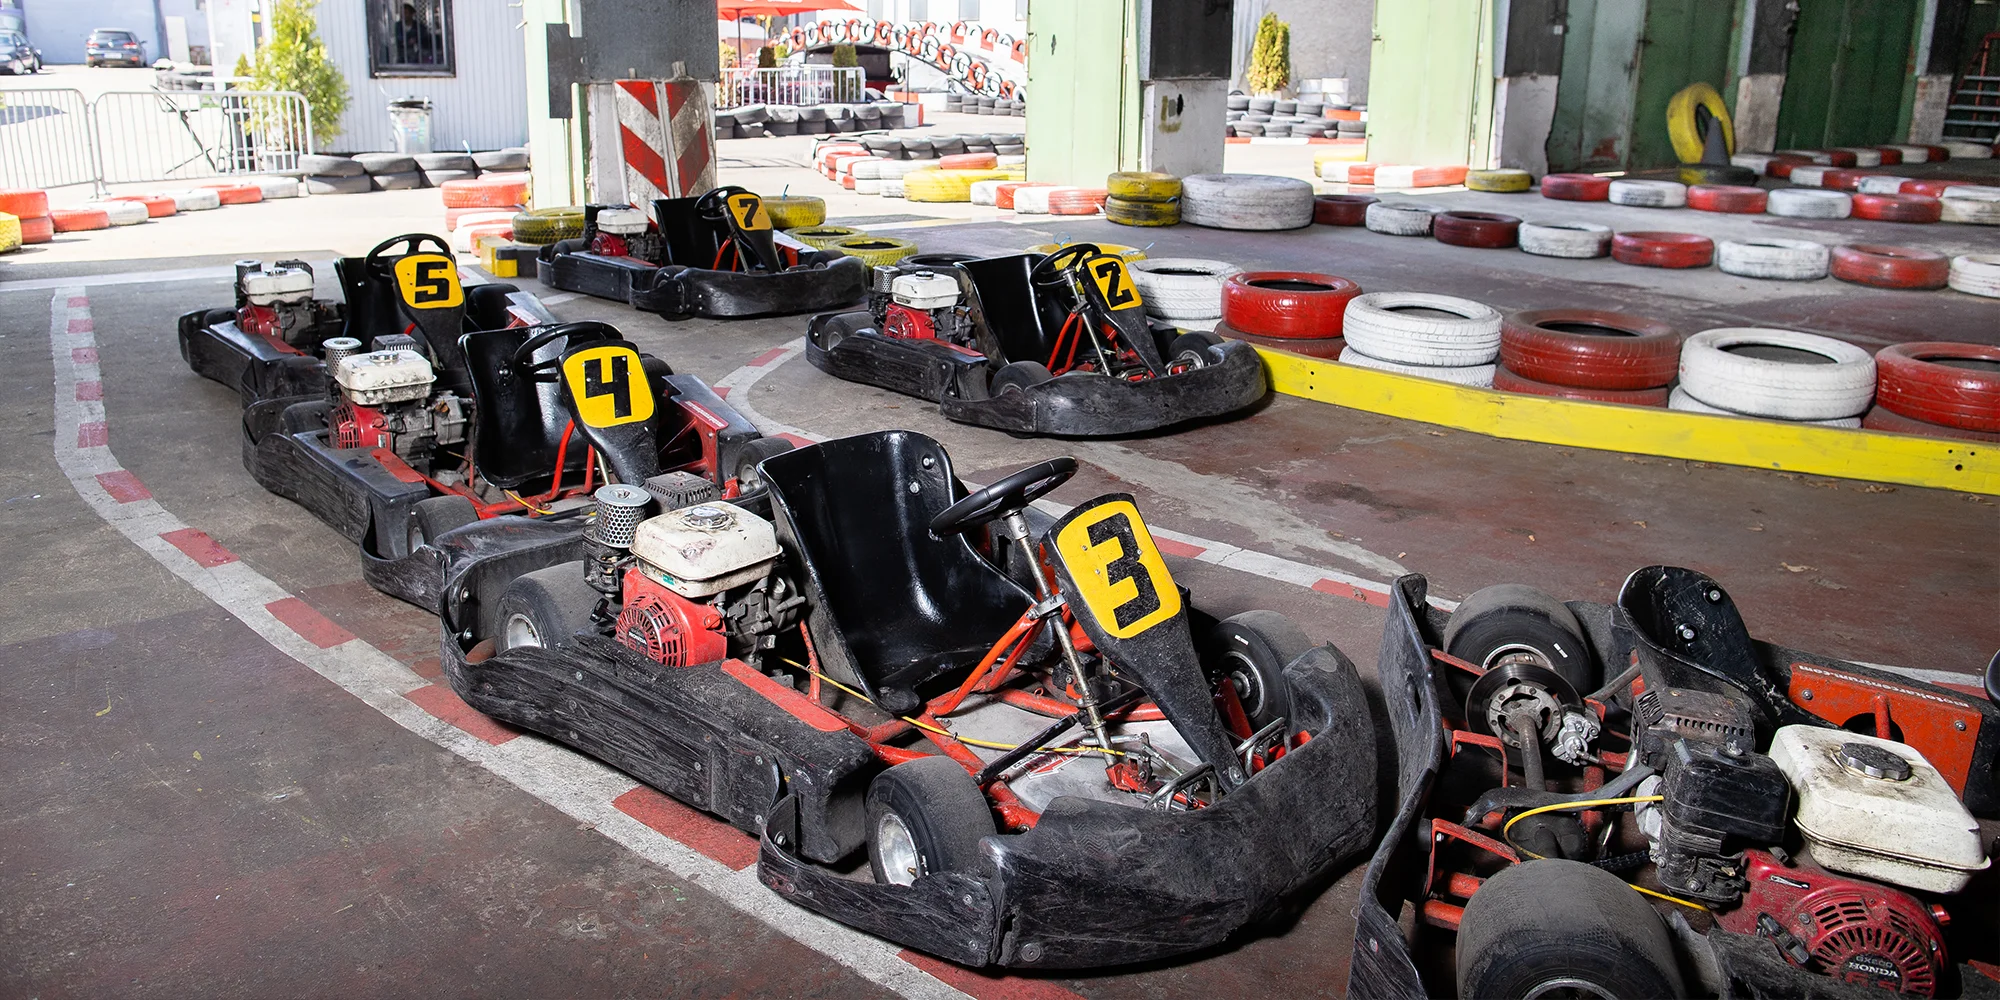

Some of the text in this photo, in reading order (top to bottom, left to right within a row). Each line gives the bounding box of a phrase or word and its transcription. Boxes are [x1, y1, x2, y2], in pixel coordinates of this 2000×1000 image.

[738, 198, 760, 228] 7
[414, 261, 450, 304] 5
[1095, 261, 1135, 308] 2
[583, 355, 632, 419] 4
[1087, 512, 1161, 631] 3
[1799, 665, 1969, 708] motokarcentrum.com
[1847, 961, 1900, 979] HONDA
